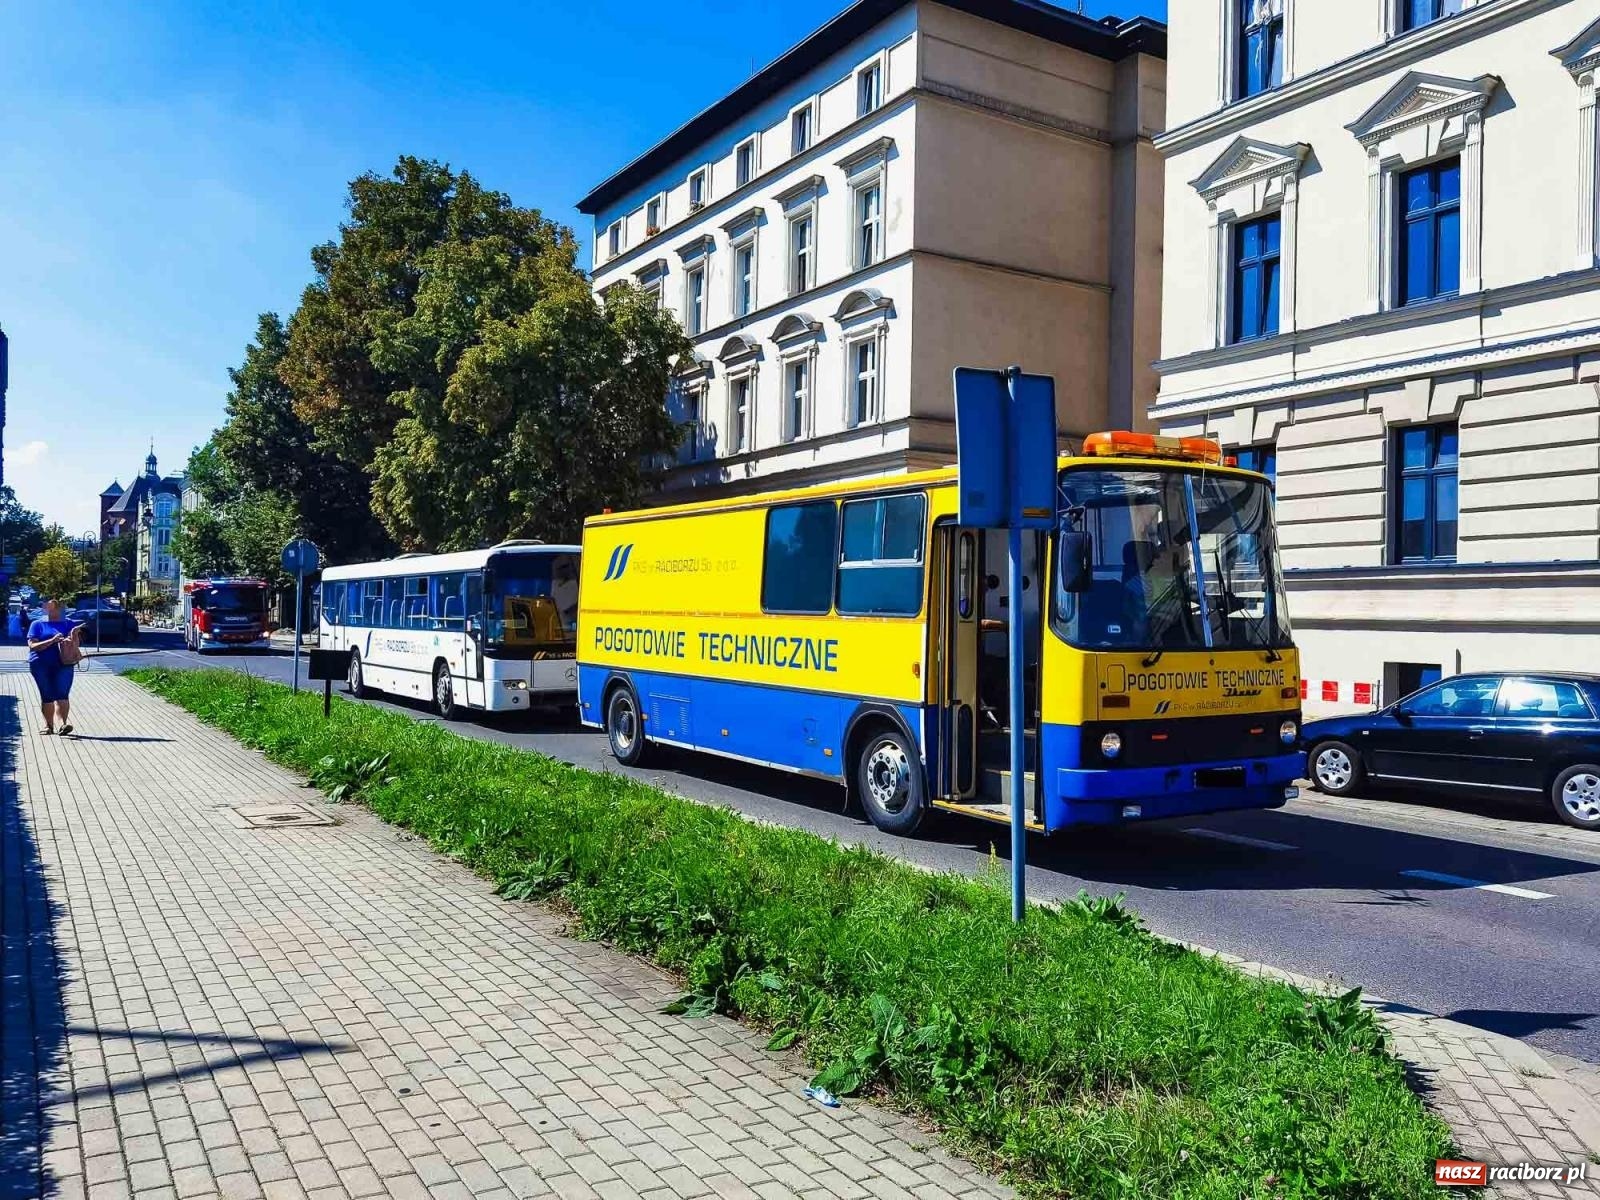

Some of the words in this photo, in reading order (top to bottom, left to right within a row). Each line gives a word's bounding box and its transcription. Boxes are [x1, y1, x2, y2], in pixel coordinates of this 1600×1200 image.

[655, 558, 699, 573] RACIBORZU
[595, 626, 686, 658] POGOTOWIE
[698, 632, 838, 672] TECHNICZNE
[1127, 671, 1208, 691] POGOTOWIE
[1214, 669, 1285, 687] TECHNICZNE
